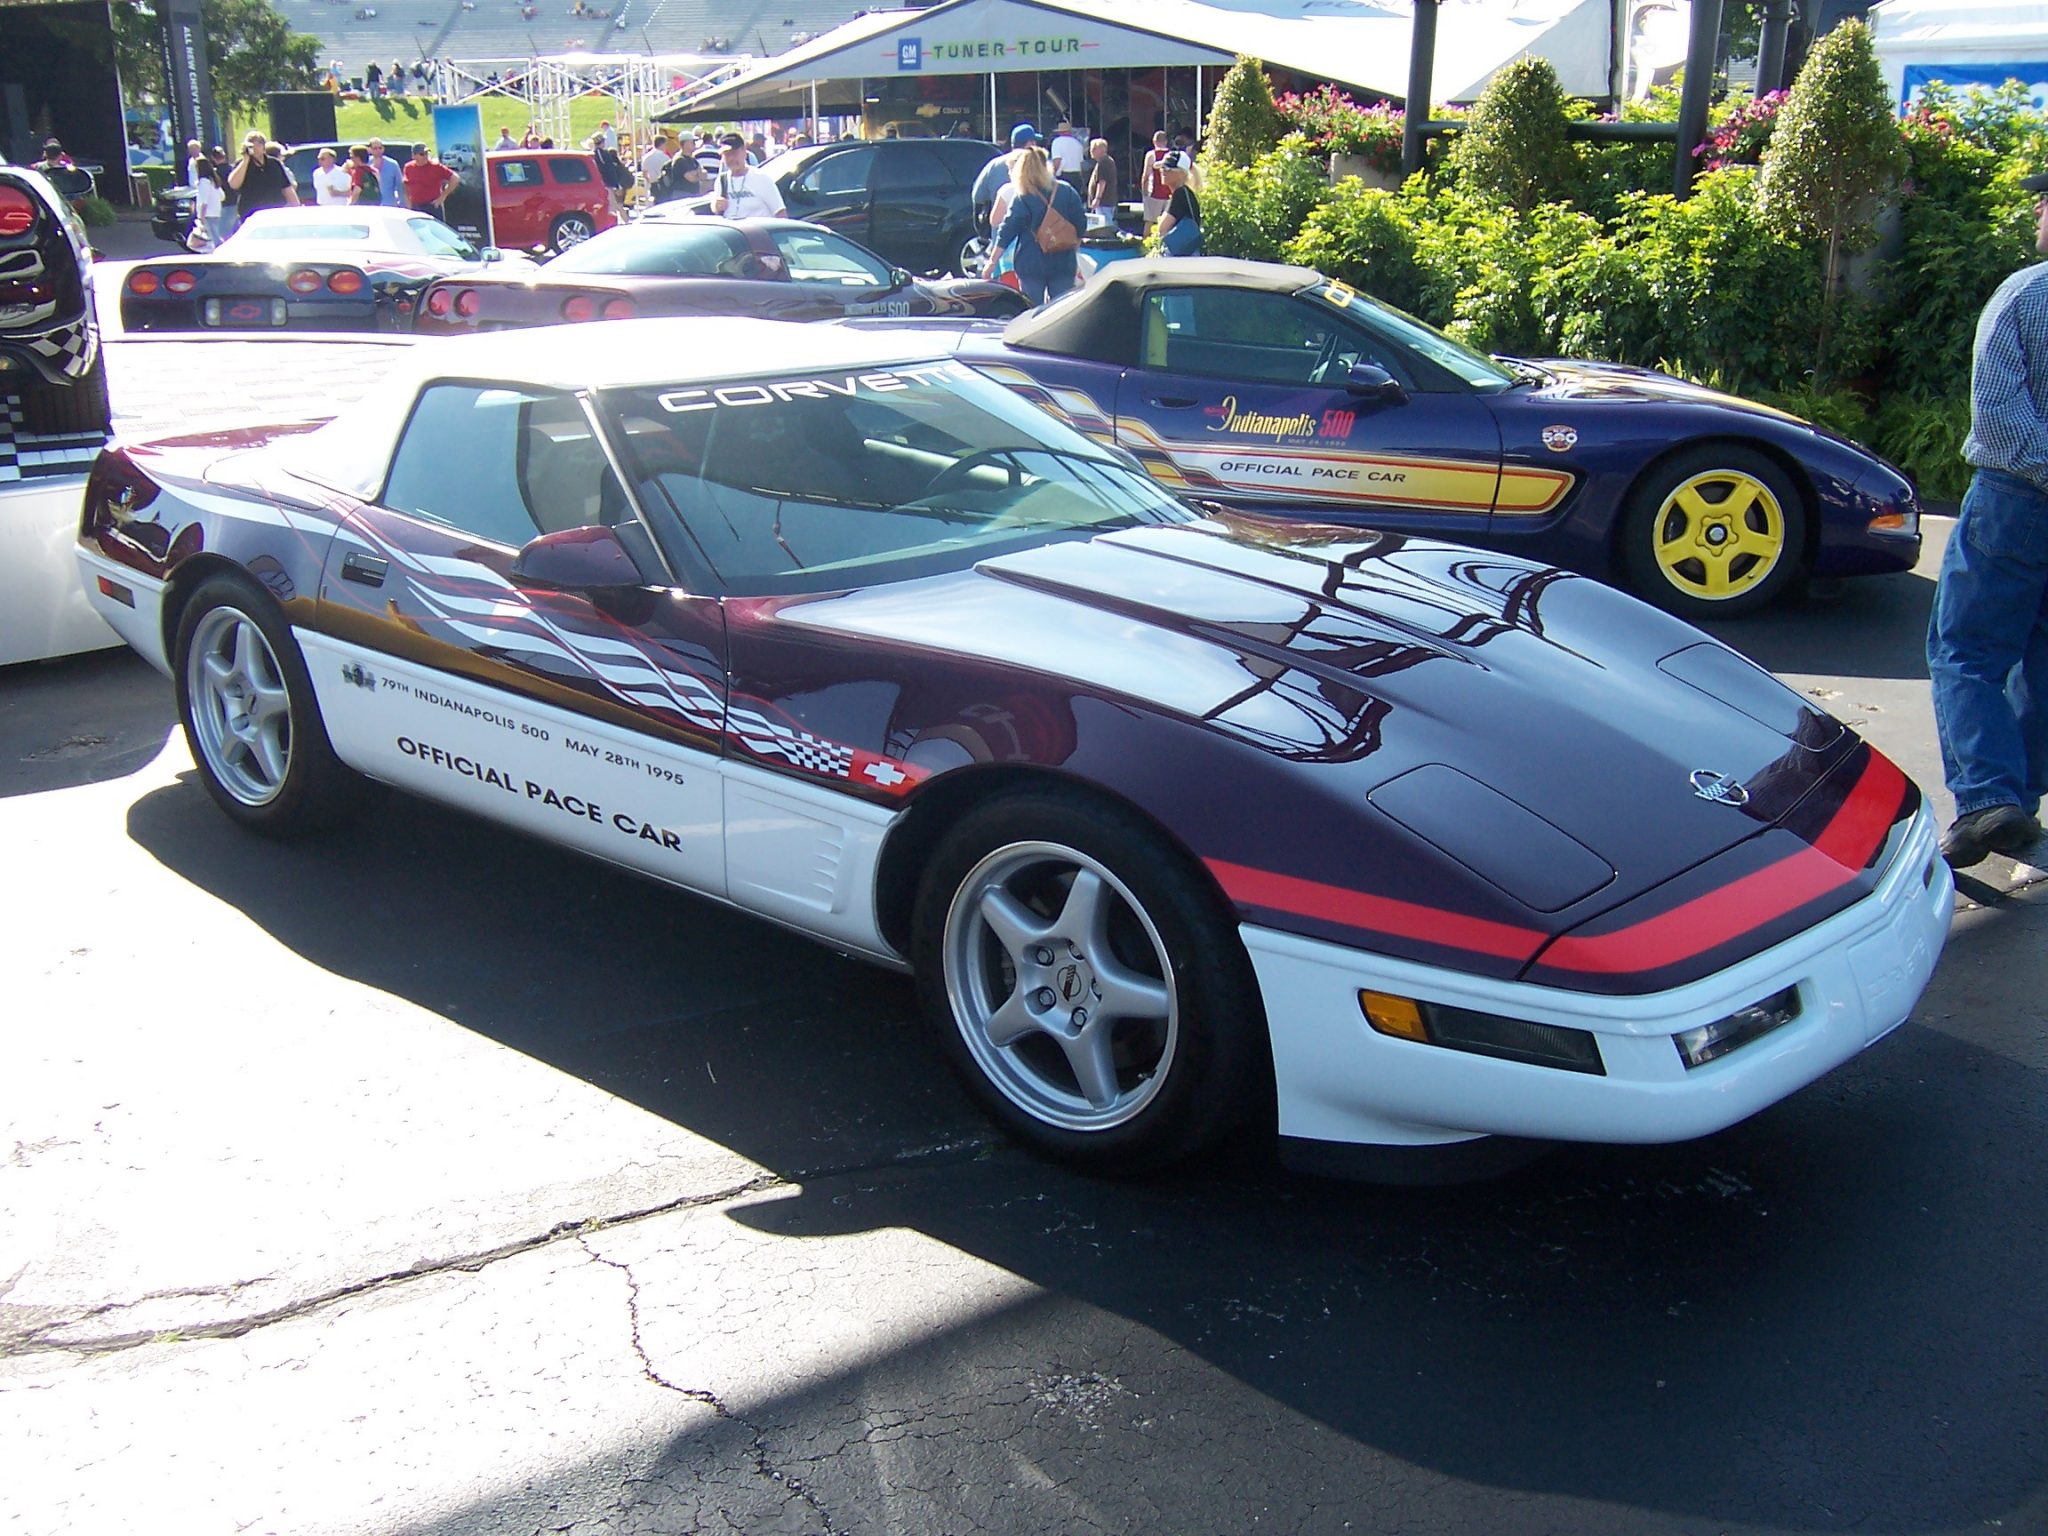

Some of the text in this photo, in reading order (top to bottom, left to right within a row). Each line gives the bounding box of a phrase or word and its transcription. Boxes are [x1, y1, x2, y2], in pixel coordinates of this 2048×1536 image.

[183, 26, 192, 45] ALL
[934, 38, 1079, 58] TUNER TOUR
[186, 46, 196, 70] NEW
[189, 71, 200, 104] CHEVY
[657, 362, 981, 413] CORVETTE
[1206, 395, 1356, 443] Indianapolis 500
[1220, 461, 1406, 483] OFFICIAL PACE CAR
[381, 677, 685, 785] 79TH INDIANAPOLIS 500 MAY 28TH 1995
[397, 736, 683, 853] OFFICIAL PACE CAR
